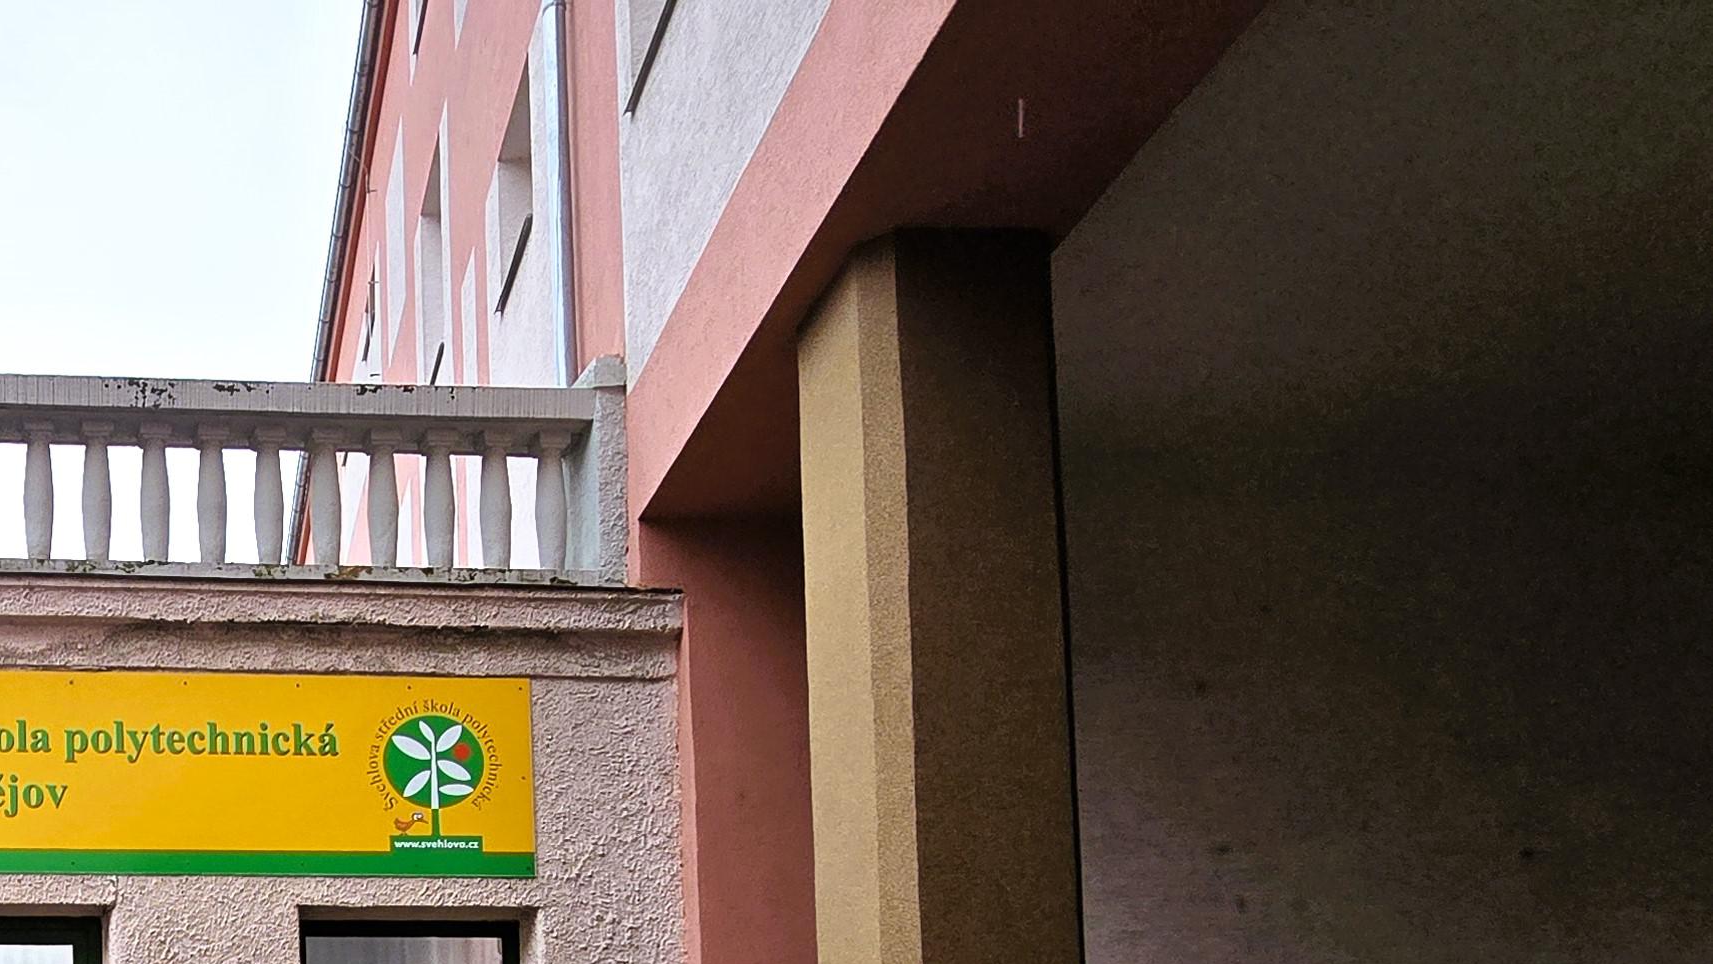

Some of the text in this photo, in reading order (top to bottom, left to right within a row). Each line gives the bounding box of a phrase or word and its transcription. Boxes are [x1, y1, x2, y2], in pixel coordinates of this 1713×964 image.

[64, 720, 340, 763] polytechnická
[374, 701, 419, 742] střední
[423, 699, 462, 718] škola
[461, 711, 503, 812] polytechnická
[394, 839, 480, 849] www.svehlova.cz
